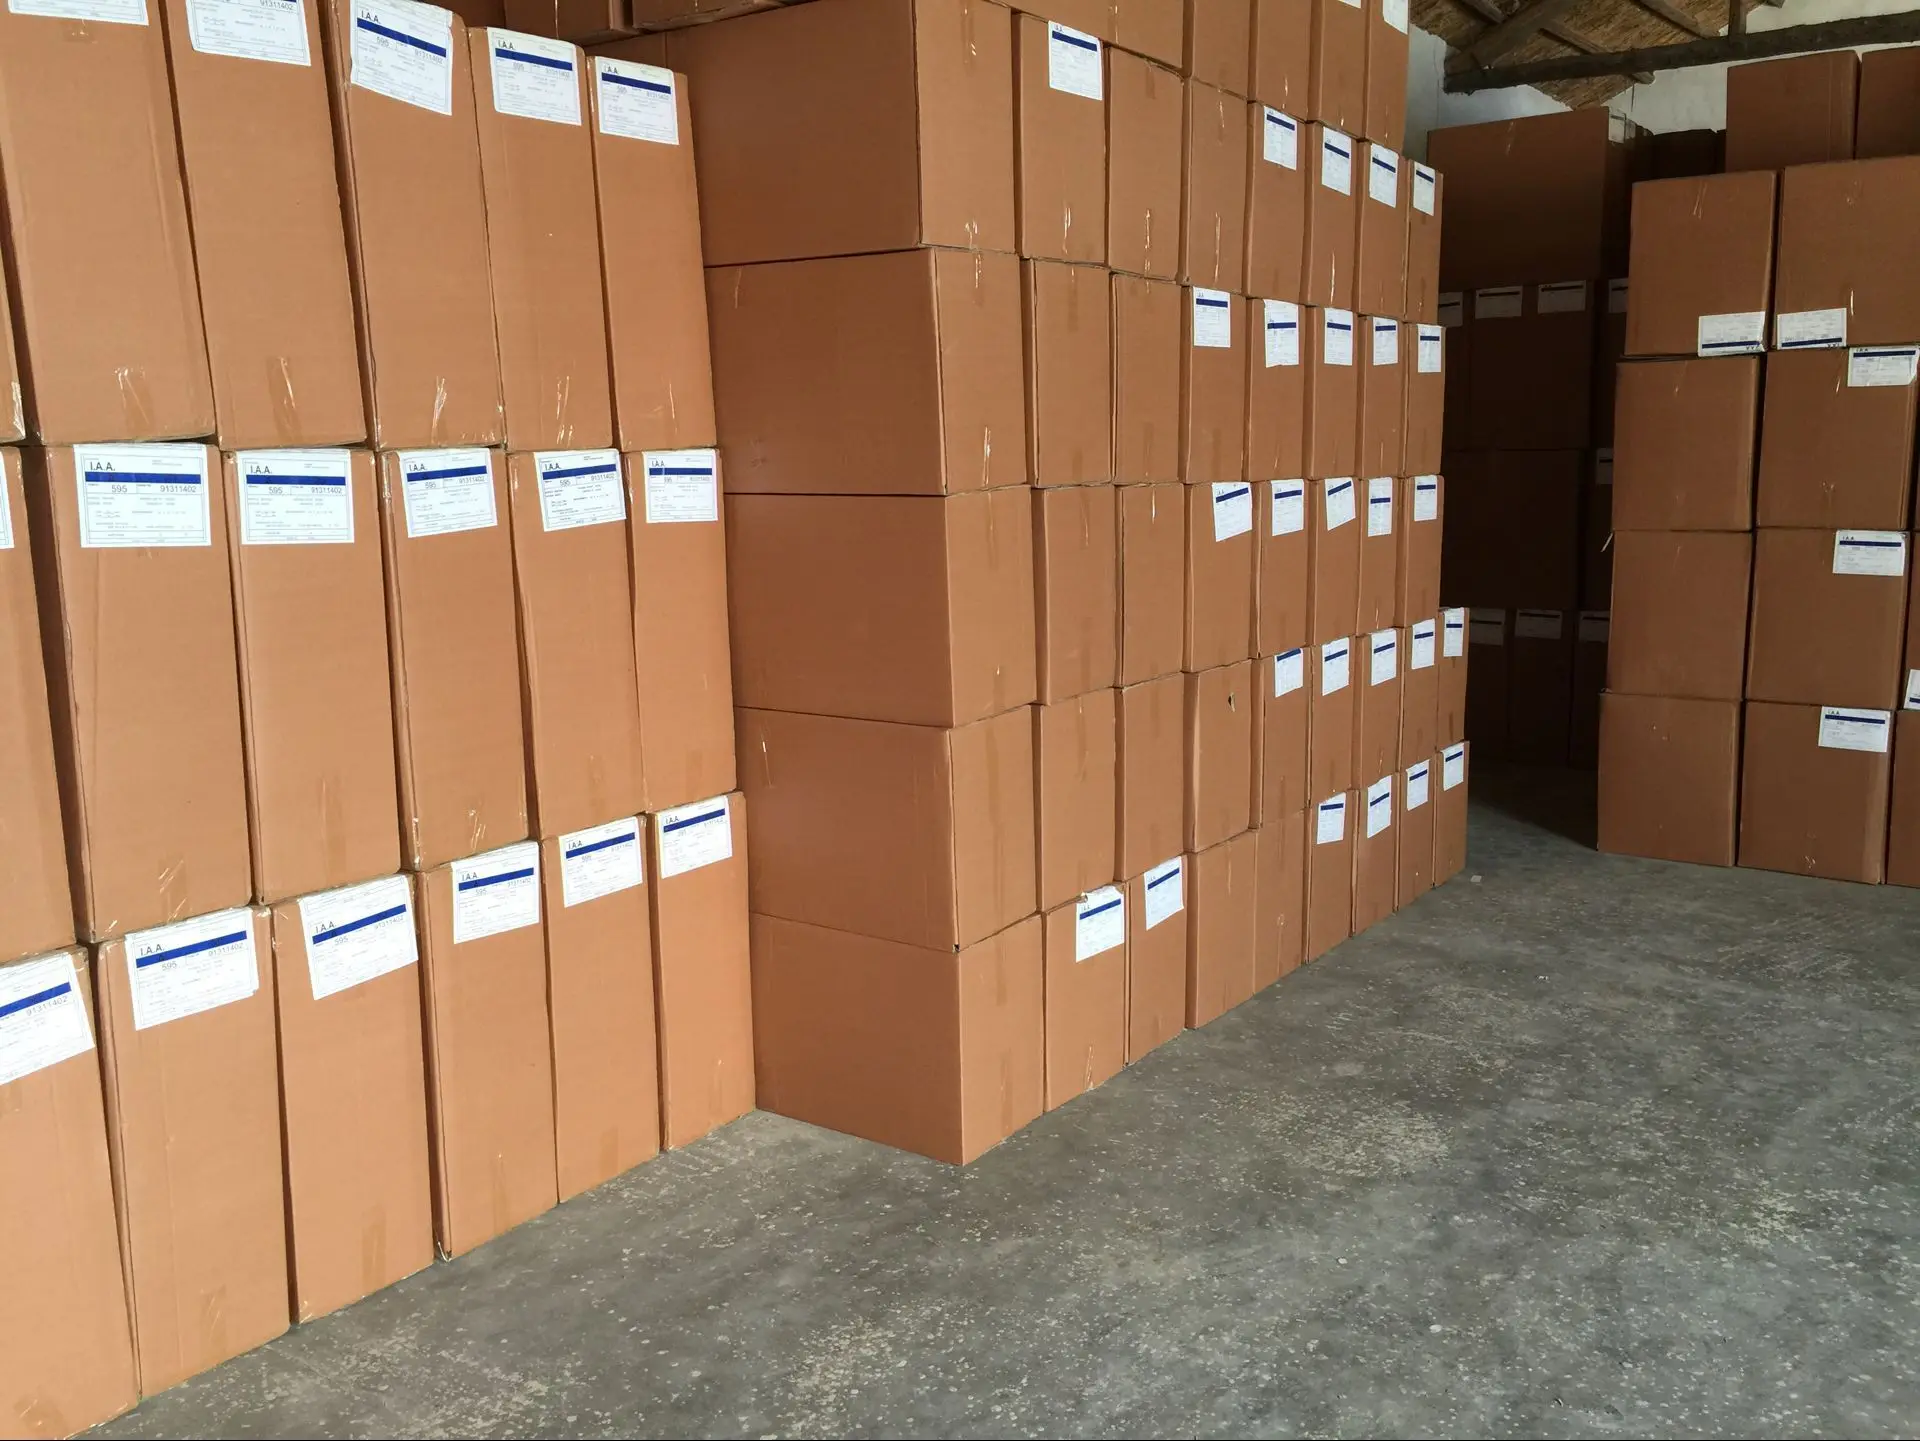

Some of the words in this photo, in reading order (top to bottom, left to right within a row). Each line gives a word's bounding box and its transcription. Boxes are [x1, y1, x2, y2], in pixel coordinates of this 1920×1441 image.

[90, 461, 116, 471] I.A.A.
[250, 465, 273, 474] I.A.A.
[111, 484, 128, 493] 595
[160, 484, 197, 493] 91311402
[268, 486, 283, 495] 595
[311, 486, 342, 494] 91311402
[315, 921, 337, 933] I.A.A.
[140, 943, 165, 956] I.A.A.
[208, 942, 244, 958] 91311402
[161, 961, 178, 971] 595
[26, 995, 69, 1017] 91311402
